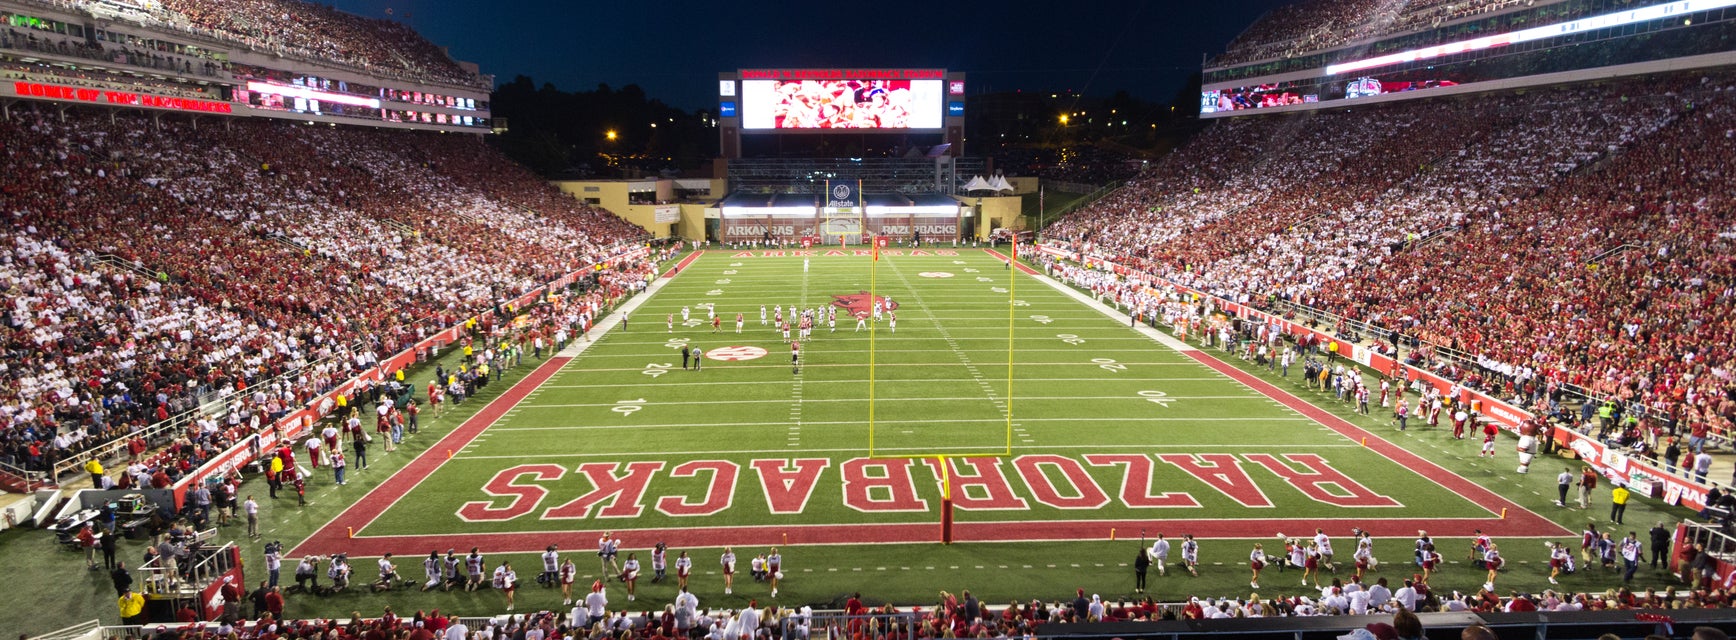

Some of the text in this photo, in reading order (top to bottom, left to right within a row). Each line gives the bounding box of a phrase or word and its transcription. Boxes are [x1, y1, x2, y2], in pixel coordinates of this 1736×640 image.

[14, 81, 74, 100] HOME
[76, 88, 100, 102] OF
[104, 91, 138, 105] THE
[726, 225, 794, 235] ARKANSAS
[642, 363, 673, 375] 20
[1090, 358, 1128, 373] 20
[1137, 390, 1177, 403] 10
[611, 398, 647, 413] 10
[1490, 406, 1520, 425] NISSAN
[455, 453, 1405, 522] RAZORBACKS
